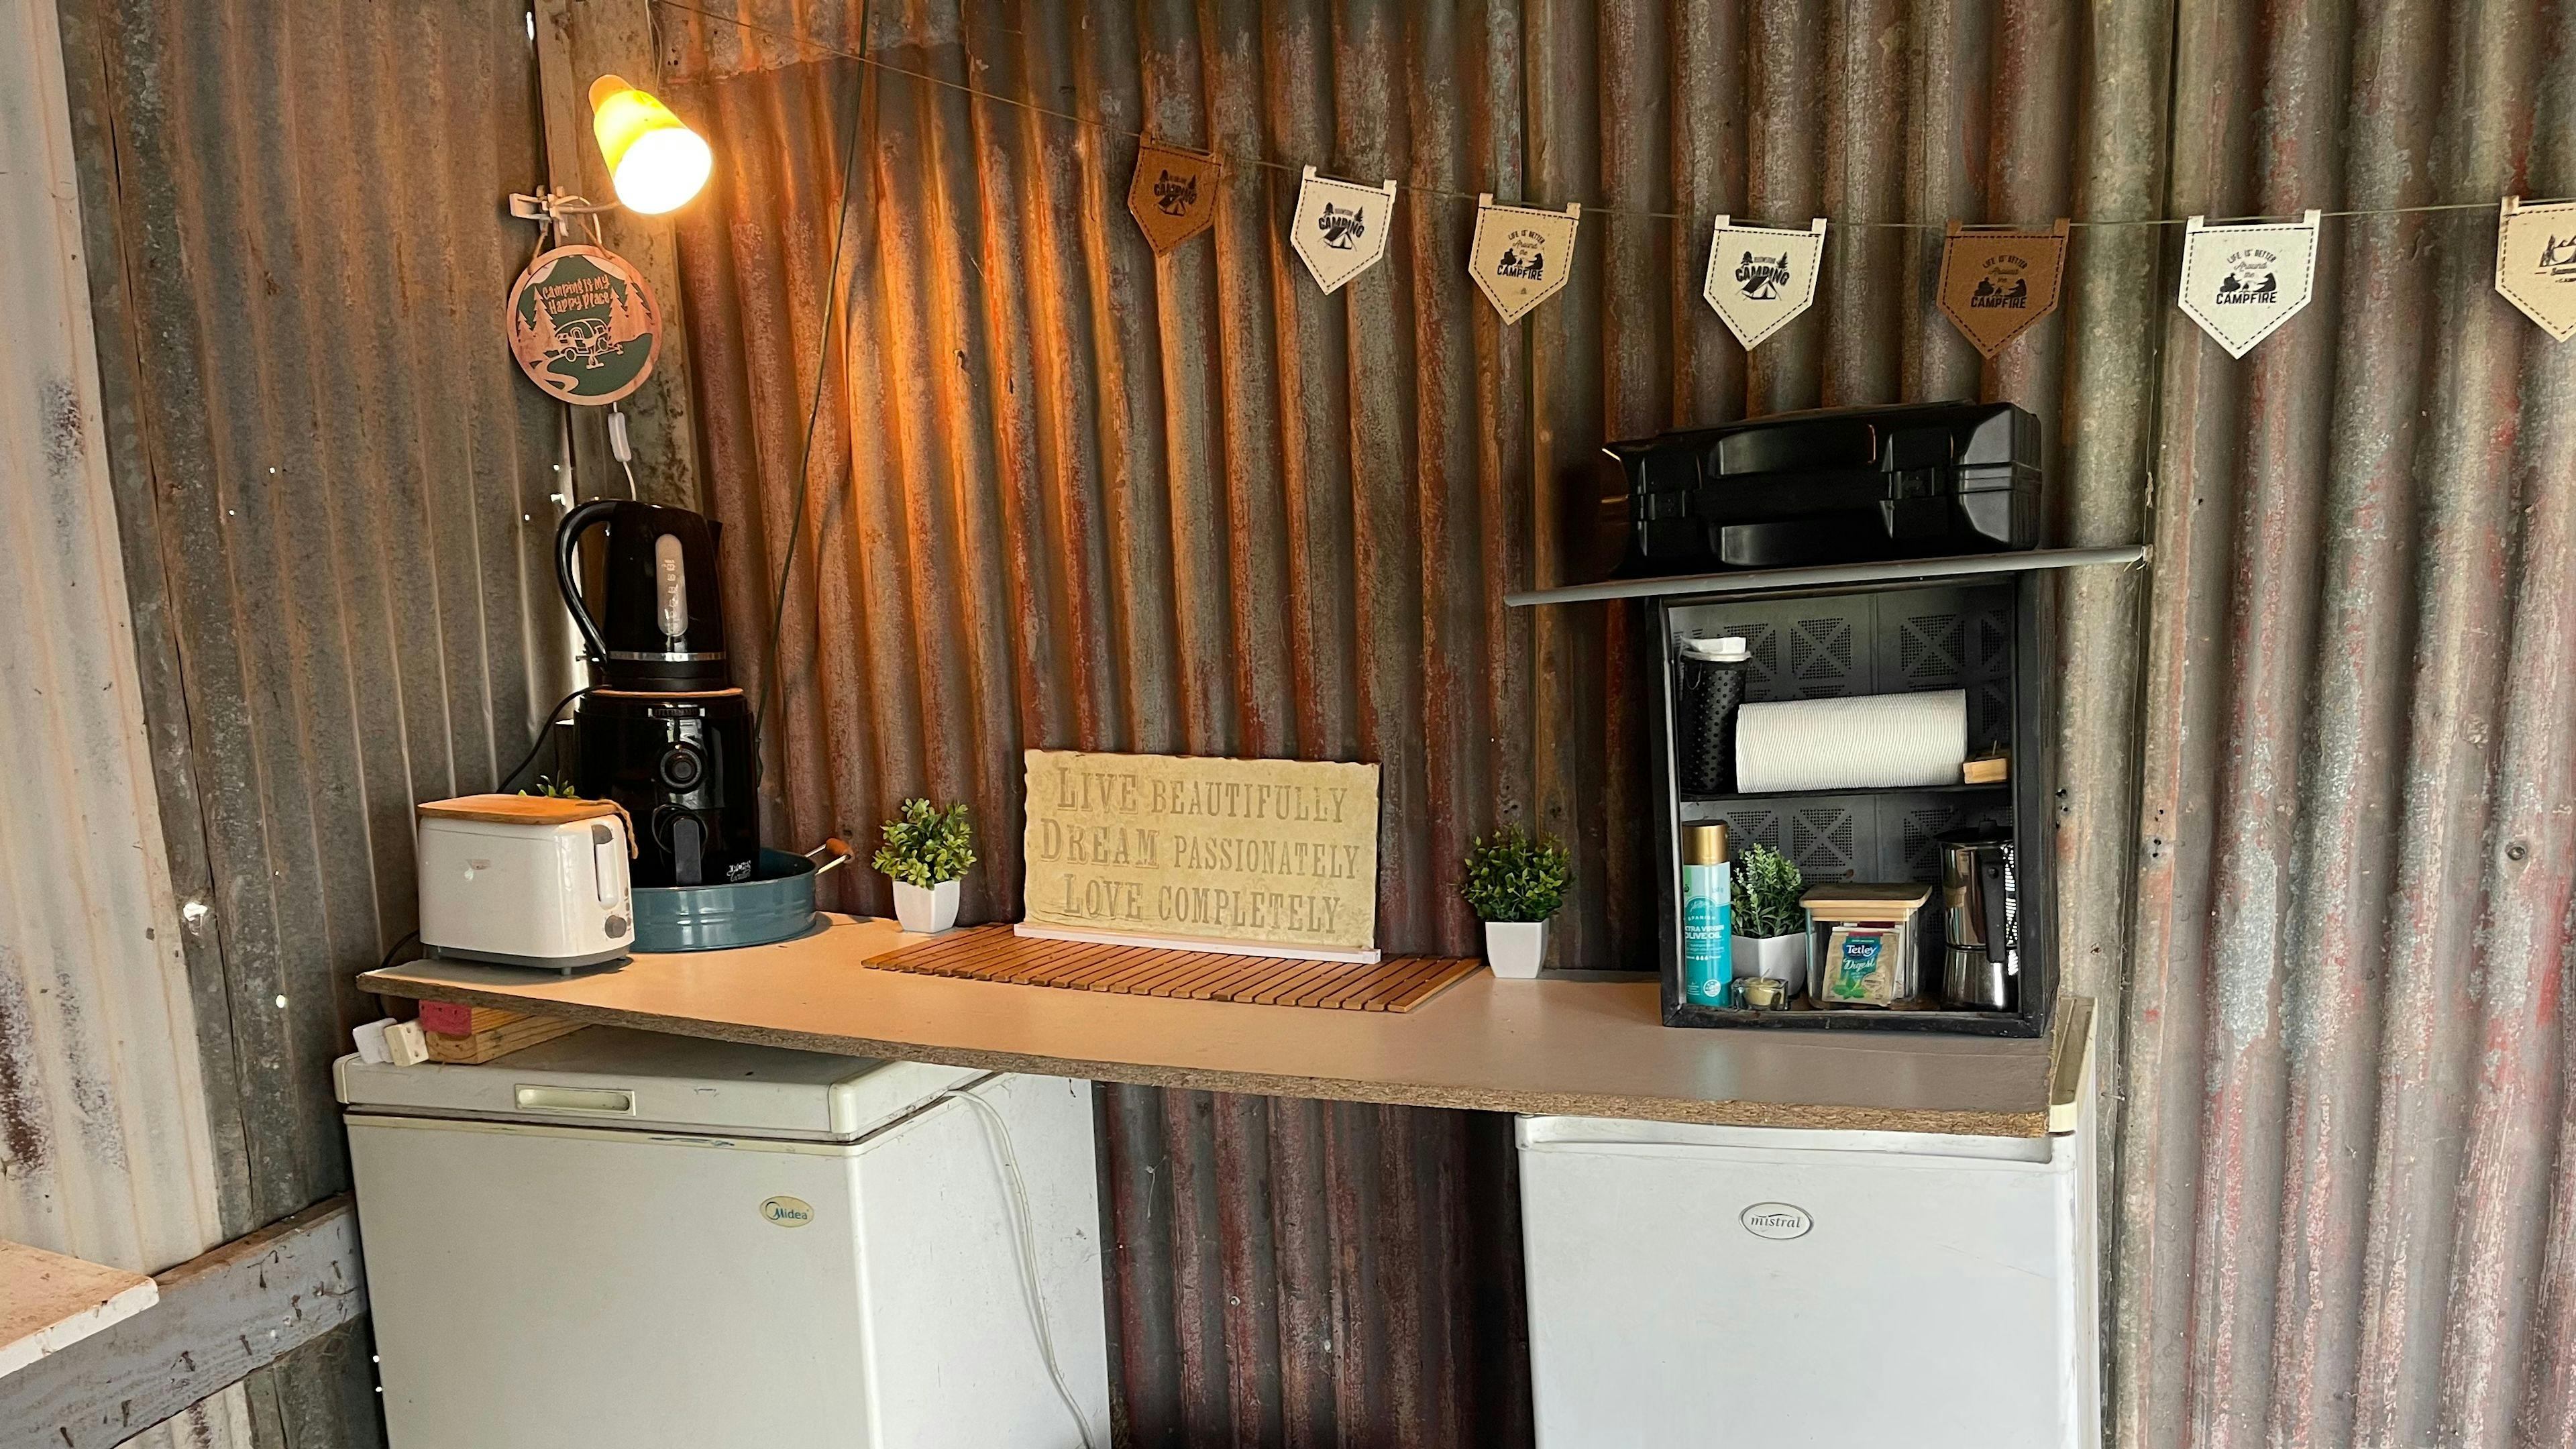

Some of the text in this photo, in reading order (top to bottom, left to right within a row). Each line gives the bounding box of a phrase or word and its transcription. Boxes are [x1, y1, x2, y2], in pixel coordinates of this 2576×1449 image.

[1319, 217, 1364, 237] CAMPING
[2227, 249, 2276, 264] LIFE IS BETTER
[1497, 265, 1543, 280] CAMPFIRE
[1735, 266, 1789, 286] CAMPING
[542, 278, 584, 300] Camping
[548, 292, 610, 314] Happy Place
[1971, 297, 2027, 309] CAMPFIRE
[2216, 292, 2277, 304] CAMPFIRE
[1057, 767, 1347, 823] LIVE BEAUTIFULLY
[1040, 818, 1359, 879] DREAM PASSIONATELY
[1064, 873, 1340, 934] LOVE COMPLETELY
[1701, 924, 1724, 932] VIRGIN
[1846, 945, 1878, 957] Tetley
[1843, 957, 1875, 973] Digest
[773, 1208, 808, 1220] Midea
[1751, 1216, 1801, 1228] mistral
